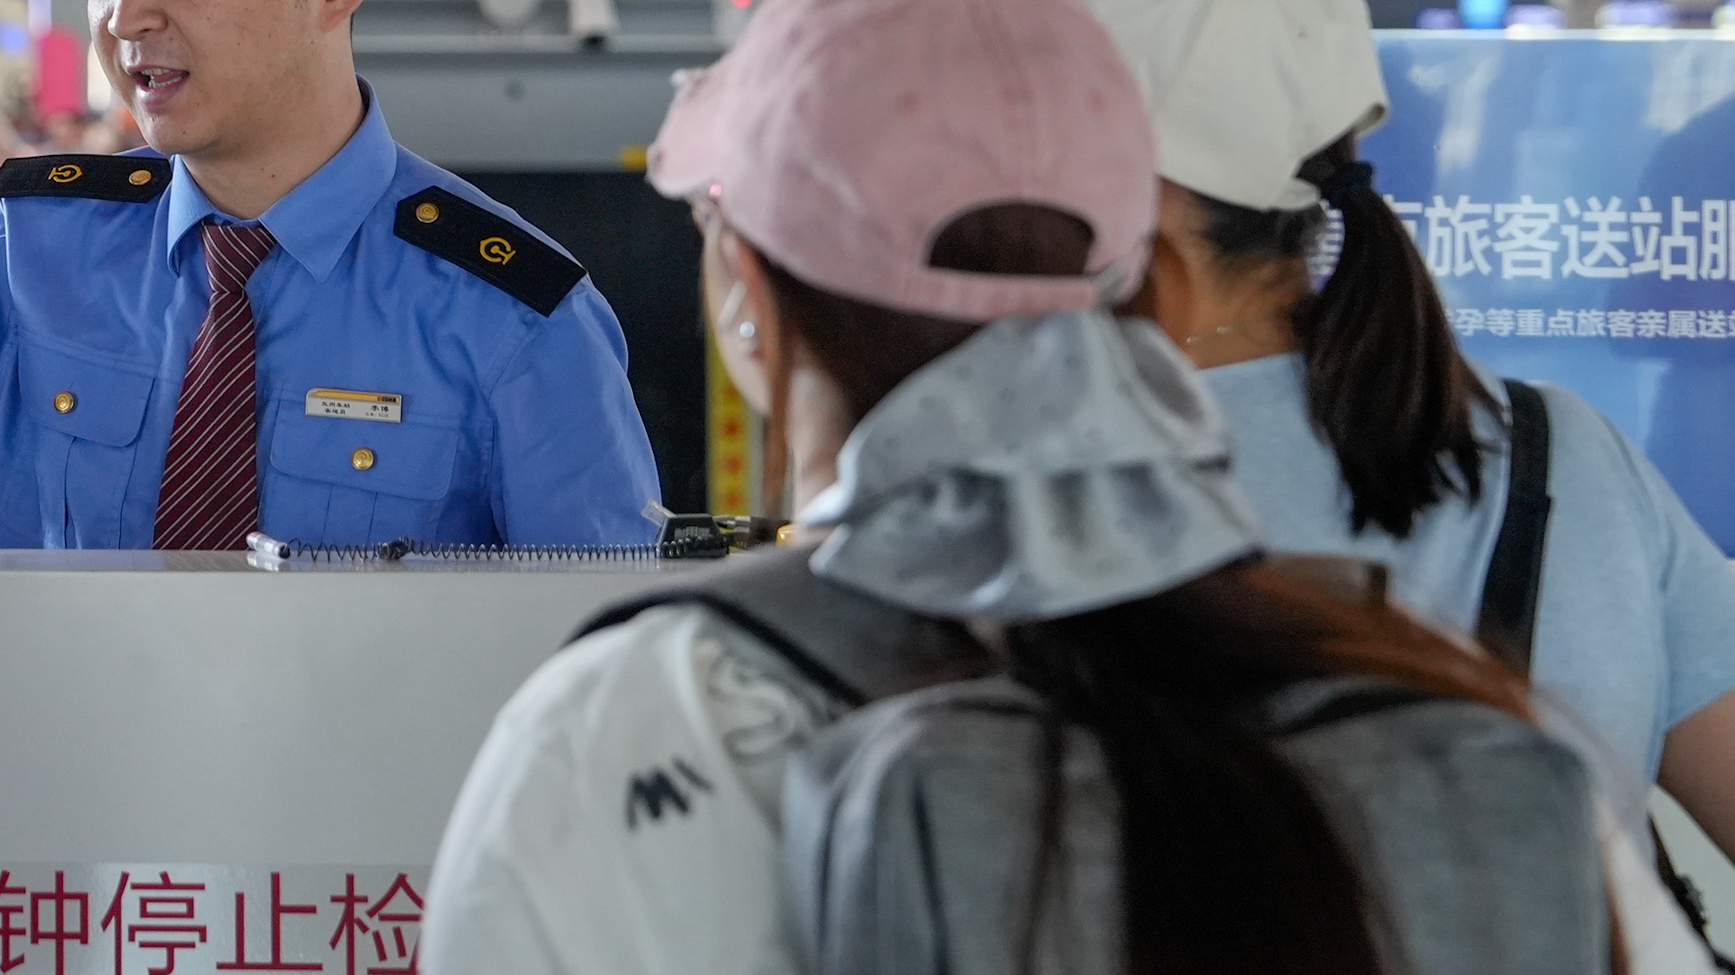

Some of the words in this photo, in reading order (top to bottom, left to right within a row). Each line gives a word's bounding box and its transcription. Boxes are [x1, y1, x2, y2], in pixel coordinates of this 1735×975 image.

[1445, 308, 1735, 339] 孕等重点旅客亲属送
